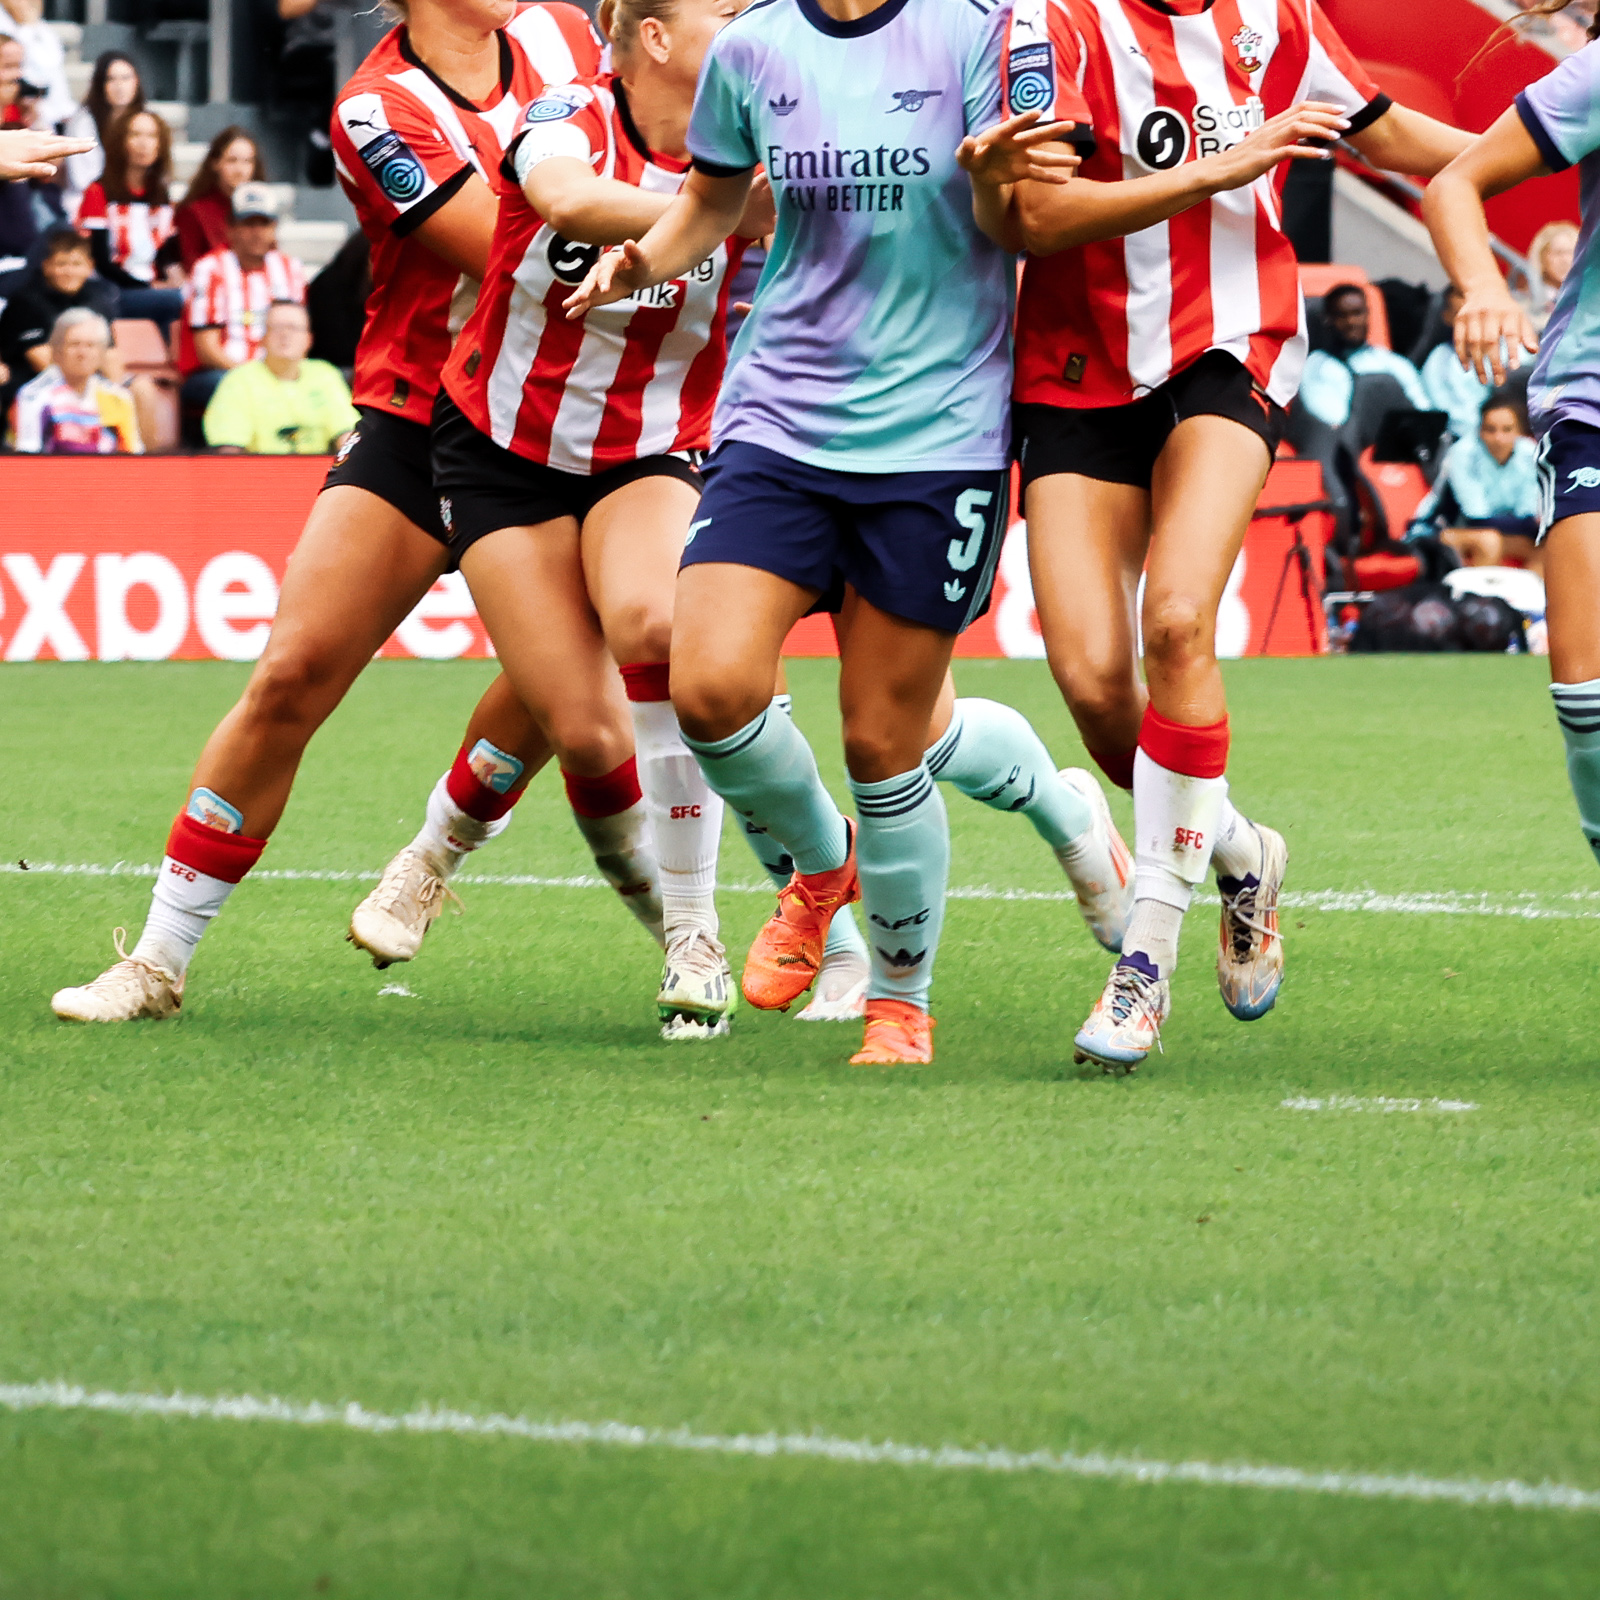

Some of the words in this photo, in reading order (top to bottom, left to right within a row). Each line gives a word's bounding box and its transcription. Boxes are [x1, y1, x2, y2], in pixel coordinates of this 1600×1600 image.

[767, 141, 931, 181] Emirates
[785, 184, 818, 212] FLY
[826, 184, 905, 212] BETTER
[946, 488, 994, 572] 5
[670, 805, 702, 819] SFC
[1175, 826, 1203, 850] SFC
